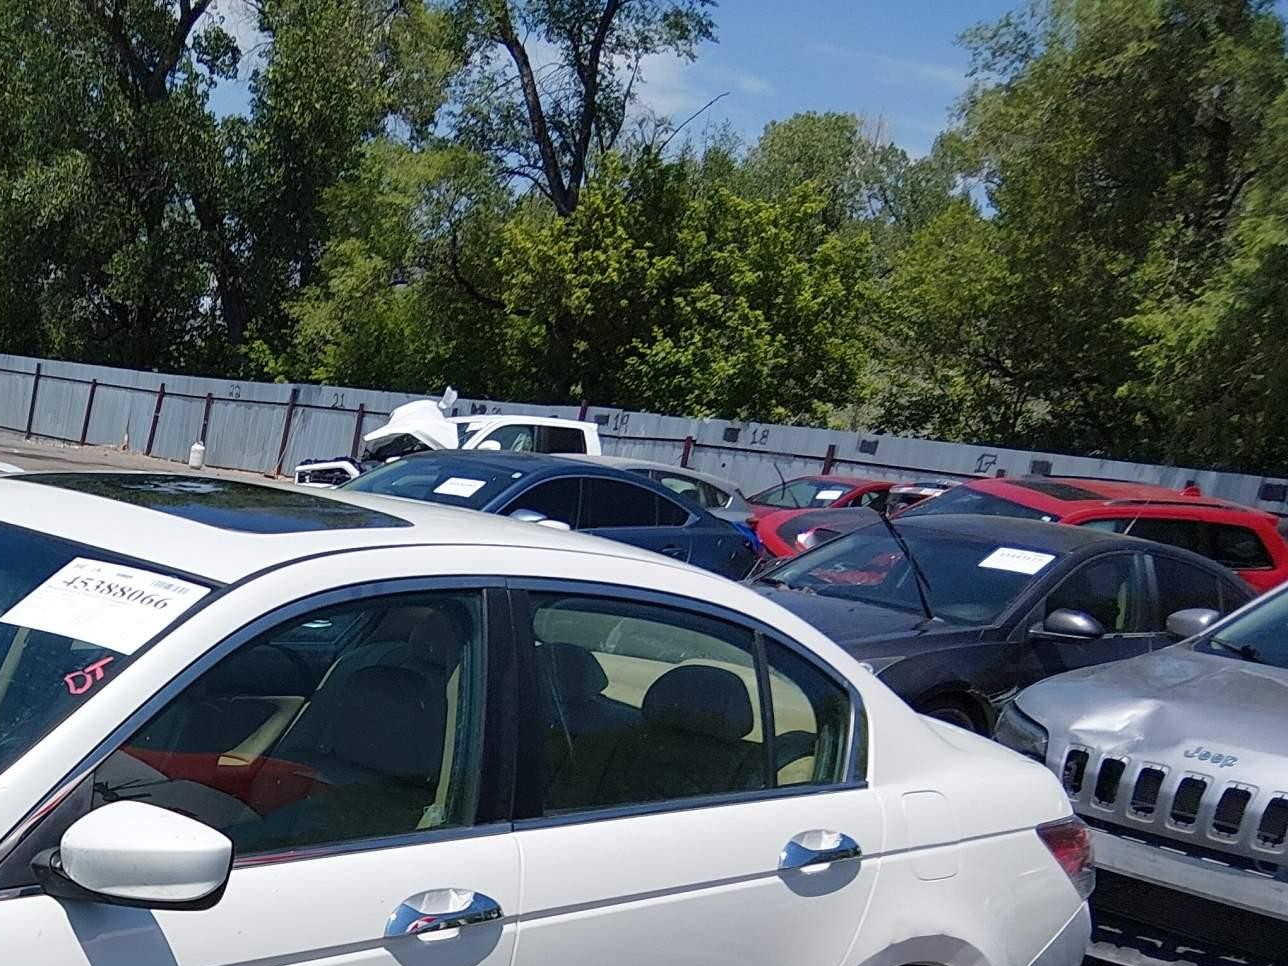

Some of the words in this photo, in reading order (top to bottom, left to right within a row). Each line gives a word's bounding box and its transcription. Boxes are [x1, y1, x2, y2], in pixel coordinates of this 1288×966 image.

[332, 392, 345, 408] 21
[613, 413, 629, 433] 19
[750, 428, 770, 446] 18
[974, 453, 998, 473] 17
[62, 575, 173, 611] 45388066
[64, 656, 115, 695] DT
[1183, 746, 1239, 768] Jeep
